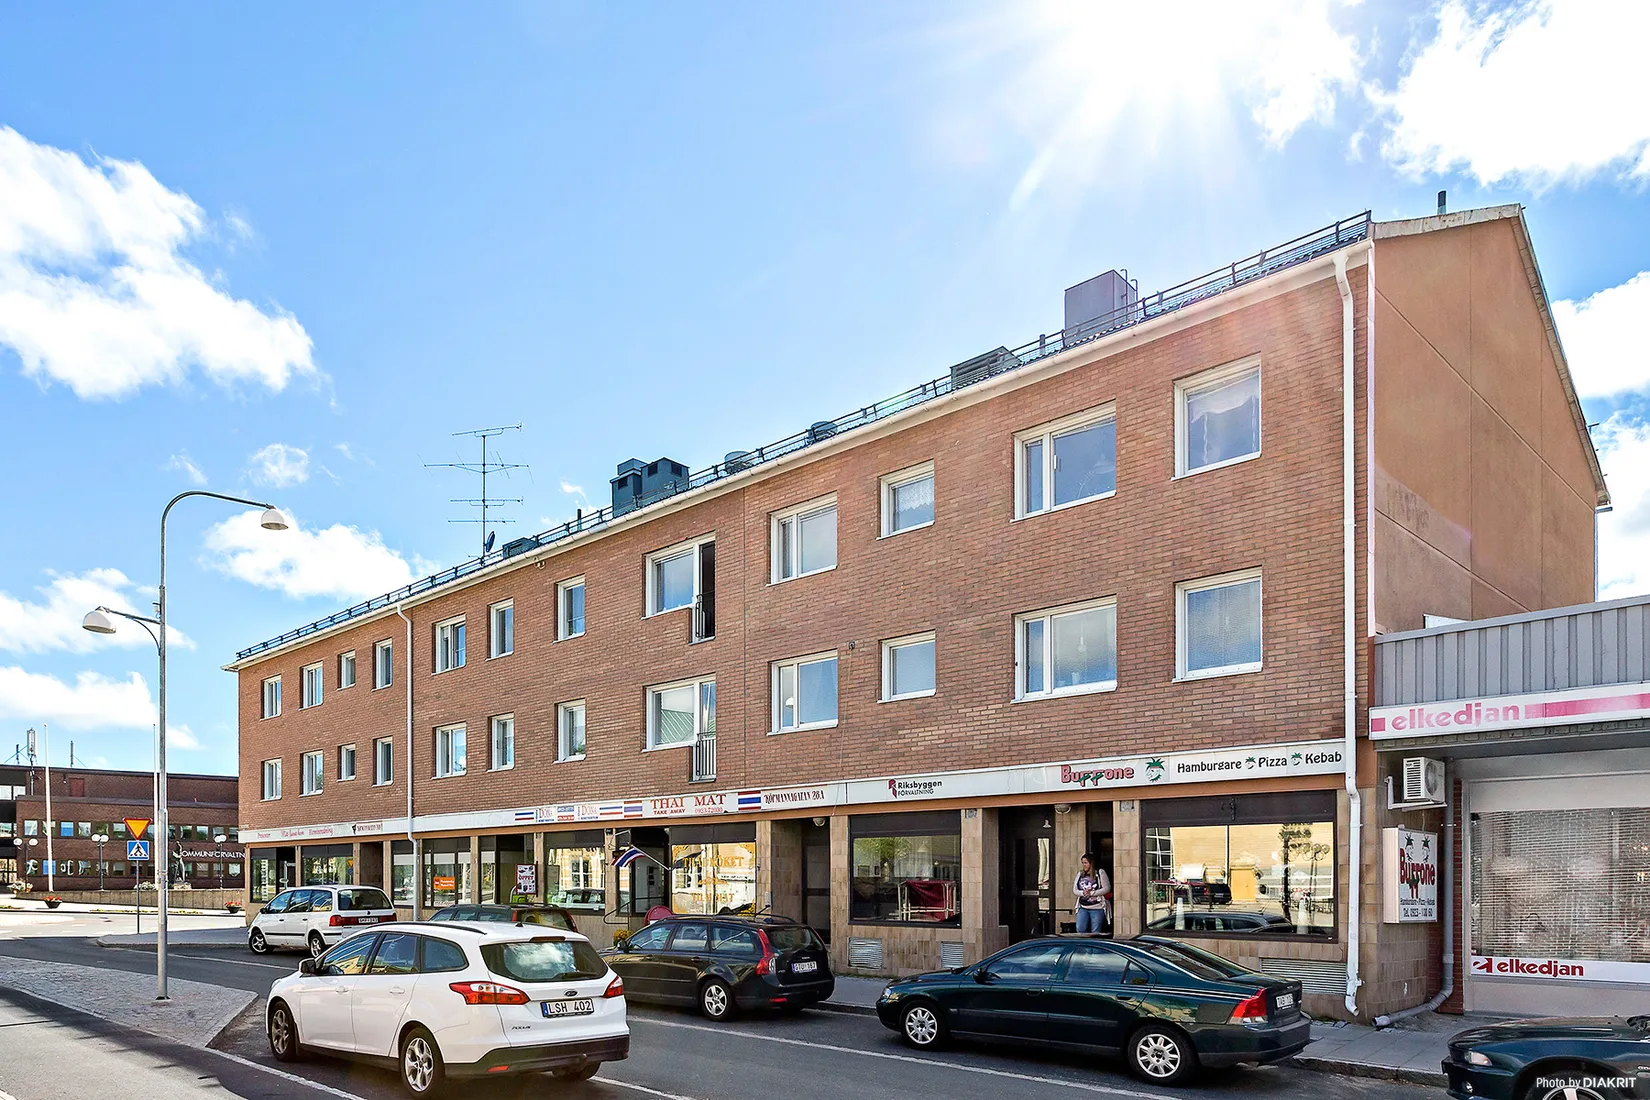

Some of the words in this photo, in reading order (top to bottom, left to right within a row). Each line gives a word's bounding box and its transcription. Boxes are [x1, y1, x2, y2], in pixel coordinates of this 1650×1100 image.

[1391, 703, 1520, 731] elkedjan
[1177, 760, 1242, 774] Hamburgare
[1258, 756, 1288, 768] Pizza
[1305, 752, 1342, 764] Kebab
[897, 781, 943, 790] Riksbyggen
[650, 797, 685, 809] THAI
[694, 794, 727, 807] MAT
[1496, 958, 1584, 978] elkedjan
[548, 1003, 568, 1014] LSH
[574, 1001, 592, 1012] 402
